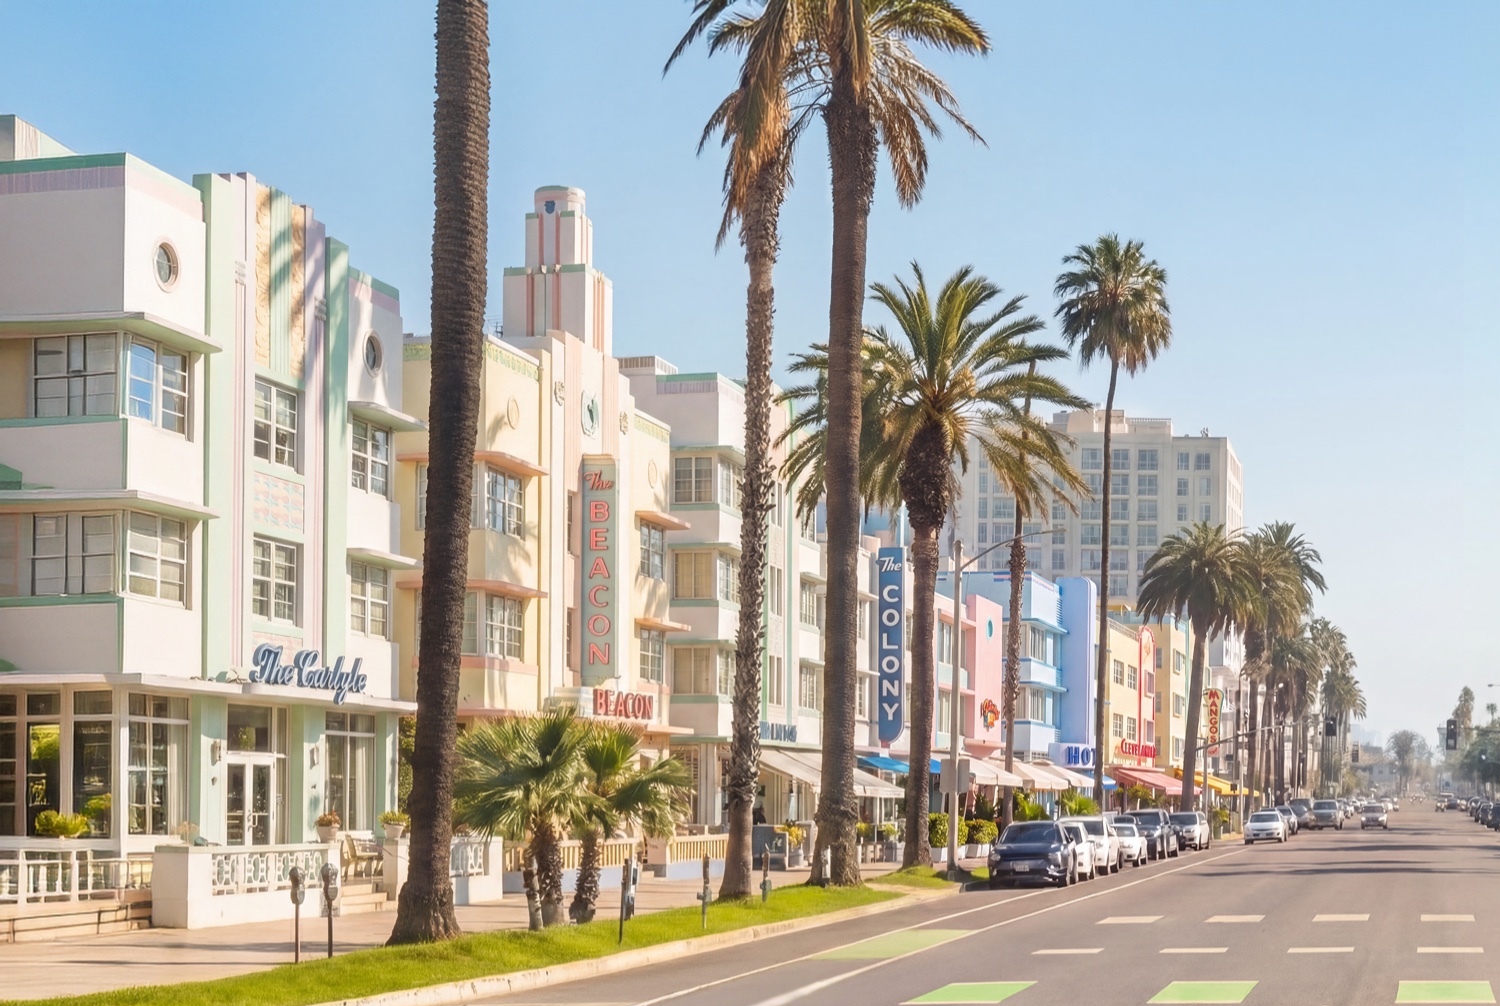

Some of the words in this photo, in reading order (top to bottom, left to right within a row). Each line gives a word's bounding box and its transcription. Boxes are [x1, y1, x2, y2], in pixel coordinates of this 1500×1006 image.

[583, 469, 614, 491] The
[588, 500, 611, 665] BEACON
[879, 556, 902, 572] The
[249, 643, 295, 685] The
[294, 650, 367, 706] Carlyle
[881, 584, 900, 721] COLONY
[593, 688, 653, 720] BEACON
[1208, 689, 1220, 743] MANGOS
